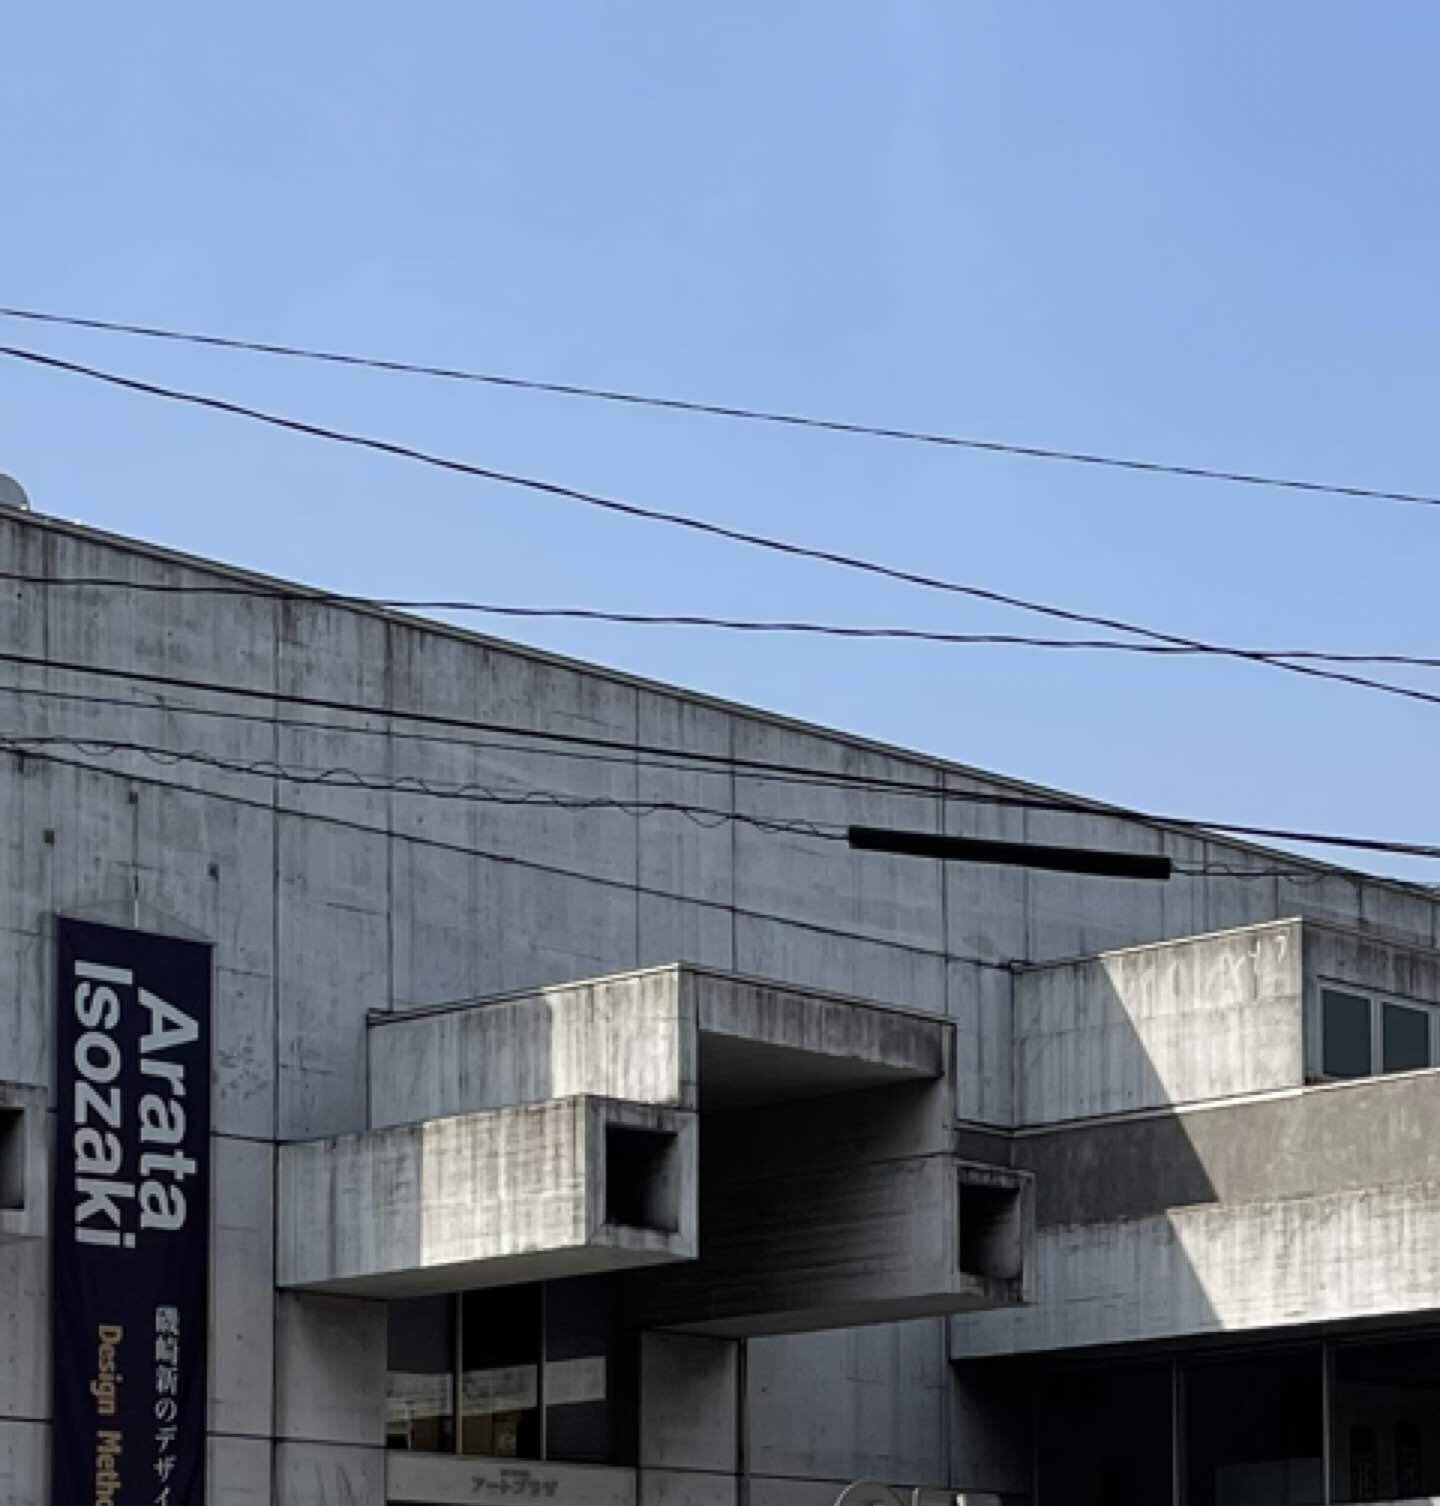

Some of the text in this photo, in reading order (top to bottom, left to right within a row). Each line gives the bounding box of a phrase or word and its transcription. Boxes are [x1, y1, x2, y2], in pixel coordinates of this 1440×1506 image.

[74, 960, 136, 1249] Isozaki
[137, 987, 199, 1231] Arata
[89, 1324, 124, 1415] Design
[471, 1477, 558, 1497] アートプラザ
